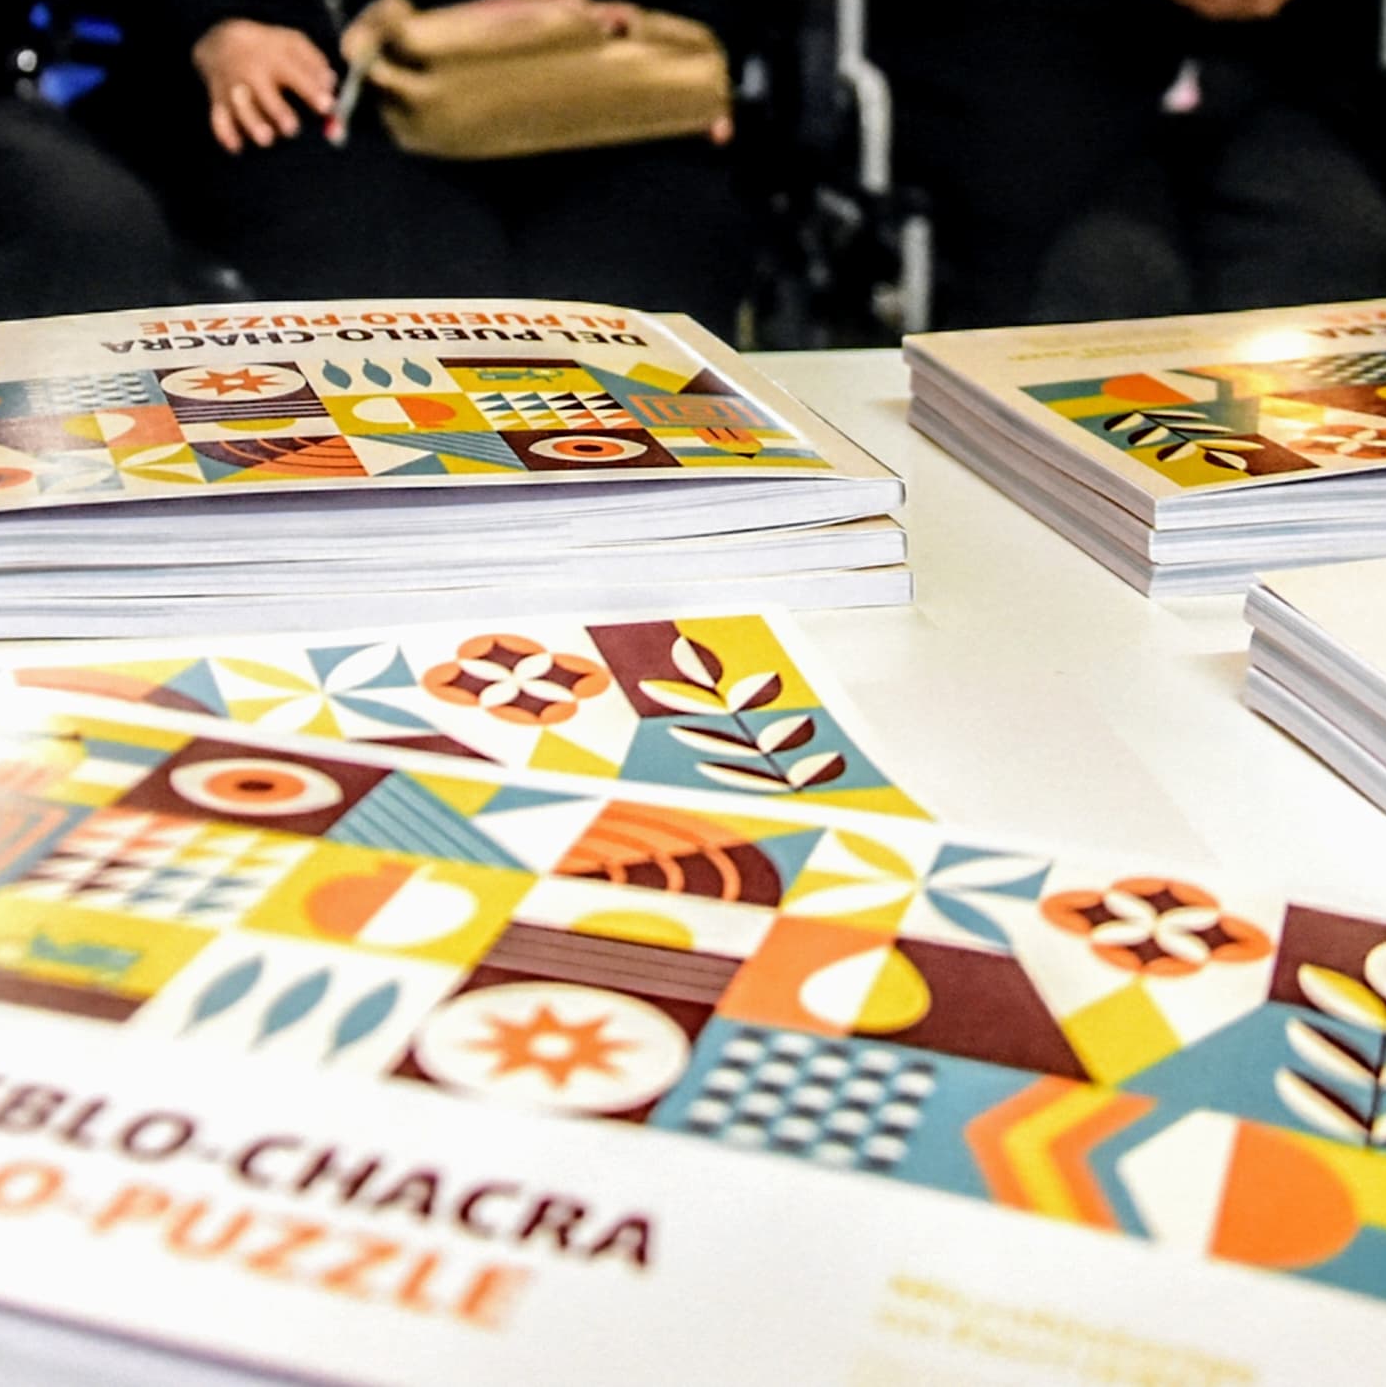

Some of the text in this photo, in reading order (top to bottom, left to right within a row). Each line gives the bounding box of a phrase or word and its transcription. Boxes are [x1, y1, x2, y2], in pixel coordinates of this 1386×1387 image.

[138, 312, 627, 336] AL PUEBLO-PUZZLE
[101, 326, 649, 355] DEL PUEBLO-CHACRA
